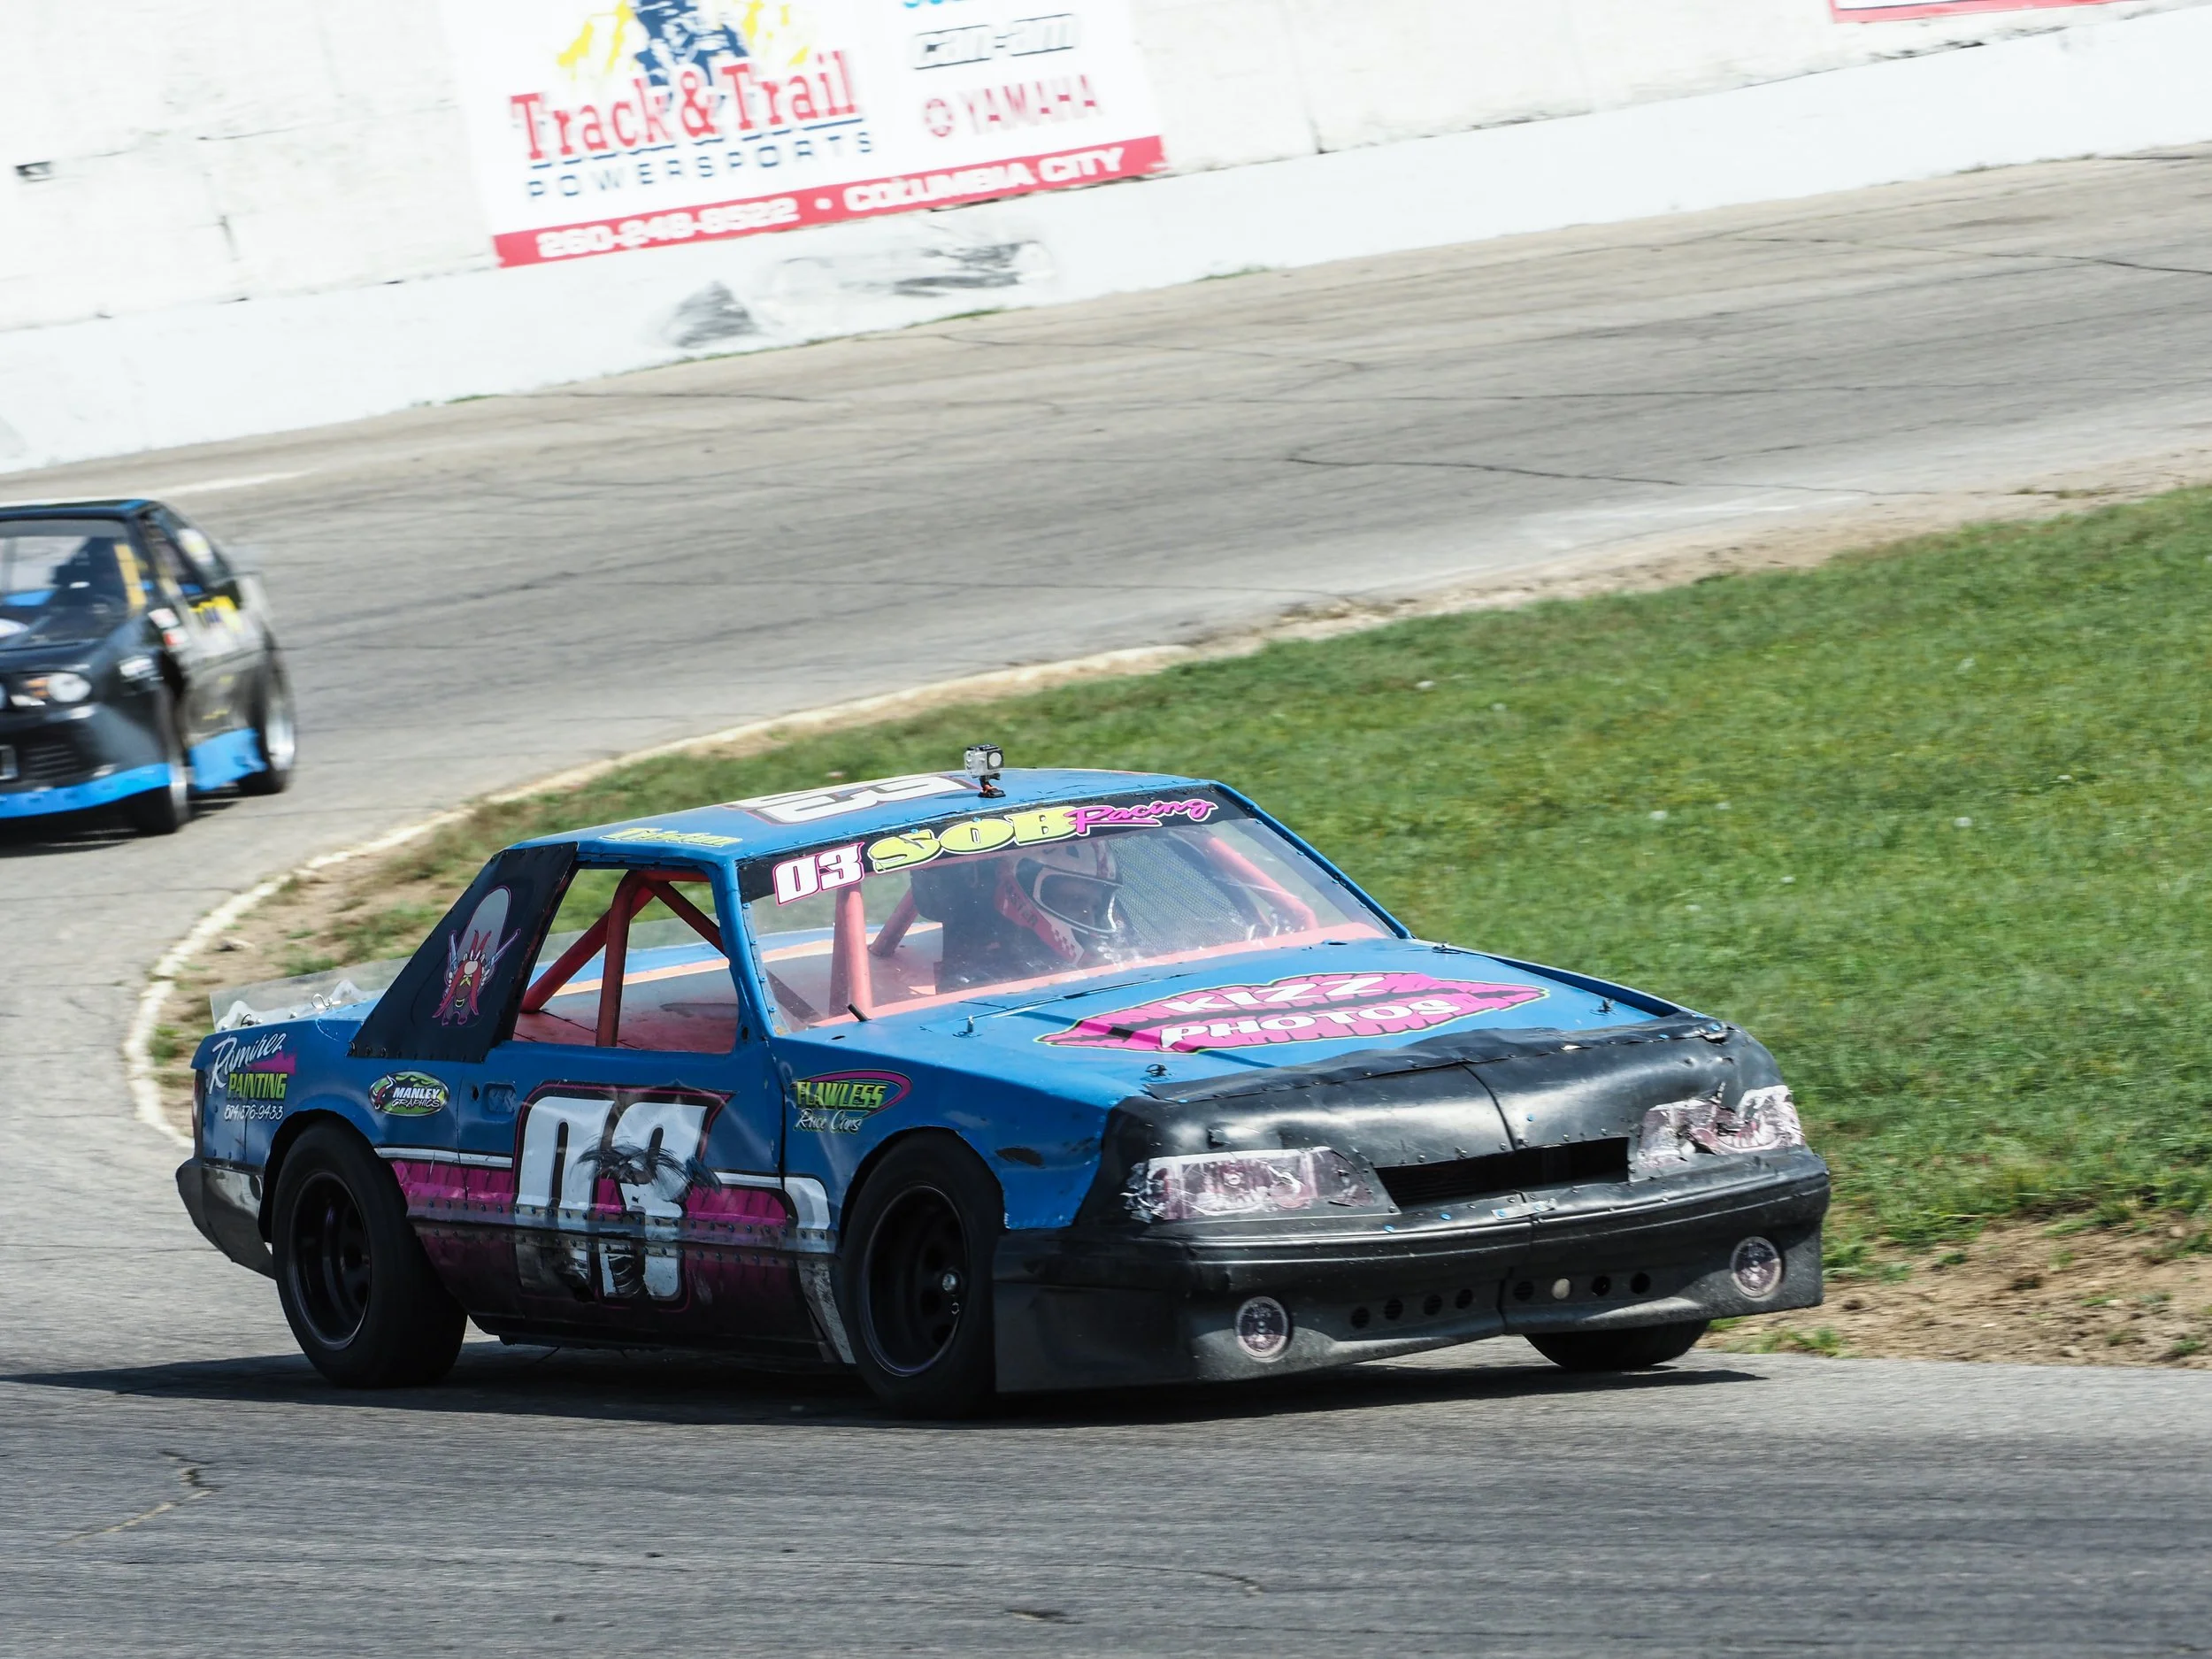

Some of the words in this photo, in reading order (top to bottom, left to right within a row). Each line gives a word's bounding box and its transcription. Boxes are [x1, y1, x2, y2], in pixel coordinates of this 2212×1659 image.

[957, 74, 1102, 134] YAMAHA
[527, 131, 872, 200] POWERSPORTS
[843, 163, 1037, 211] COLUMBIA
[1038, 148, 1125, 182] CITY
[772, 841, 865, 905] 03
[868, 806, 1076, 873] SOB
[1062, 799, 1219, 835] Racing
[1166, 975, 1387, 1014] KIZZ
[1160, 998, 1458, 1048] PHOTOS
[227, 1072, 288, 1100] PAINTING
[391, 1098, 441, 1109] GRAPHICS
[392, 1087, 441, 1100] MANLEY
[796, 1081, 888, 1110] FLAWLESS
[830, 1110, 864, 1133] Cars
